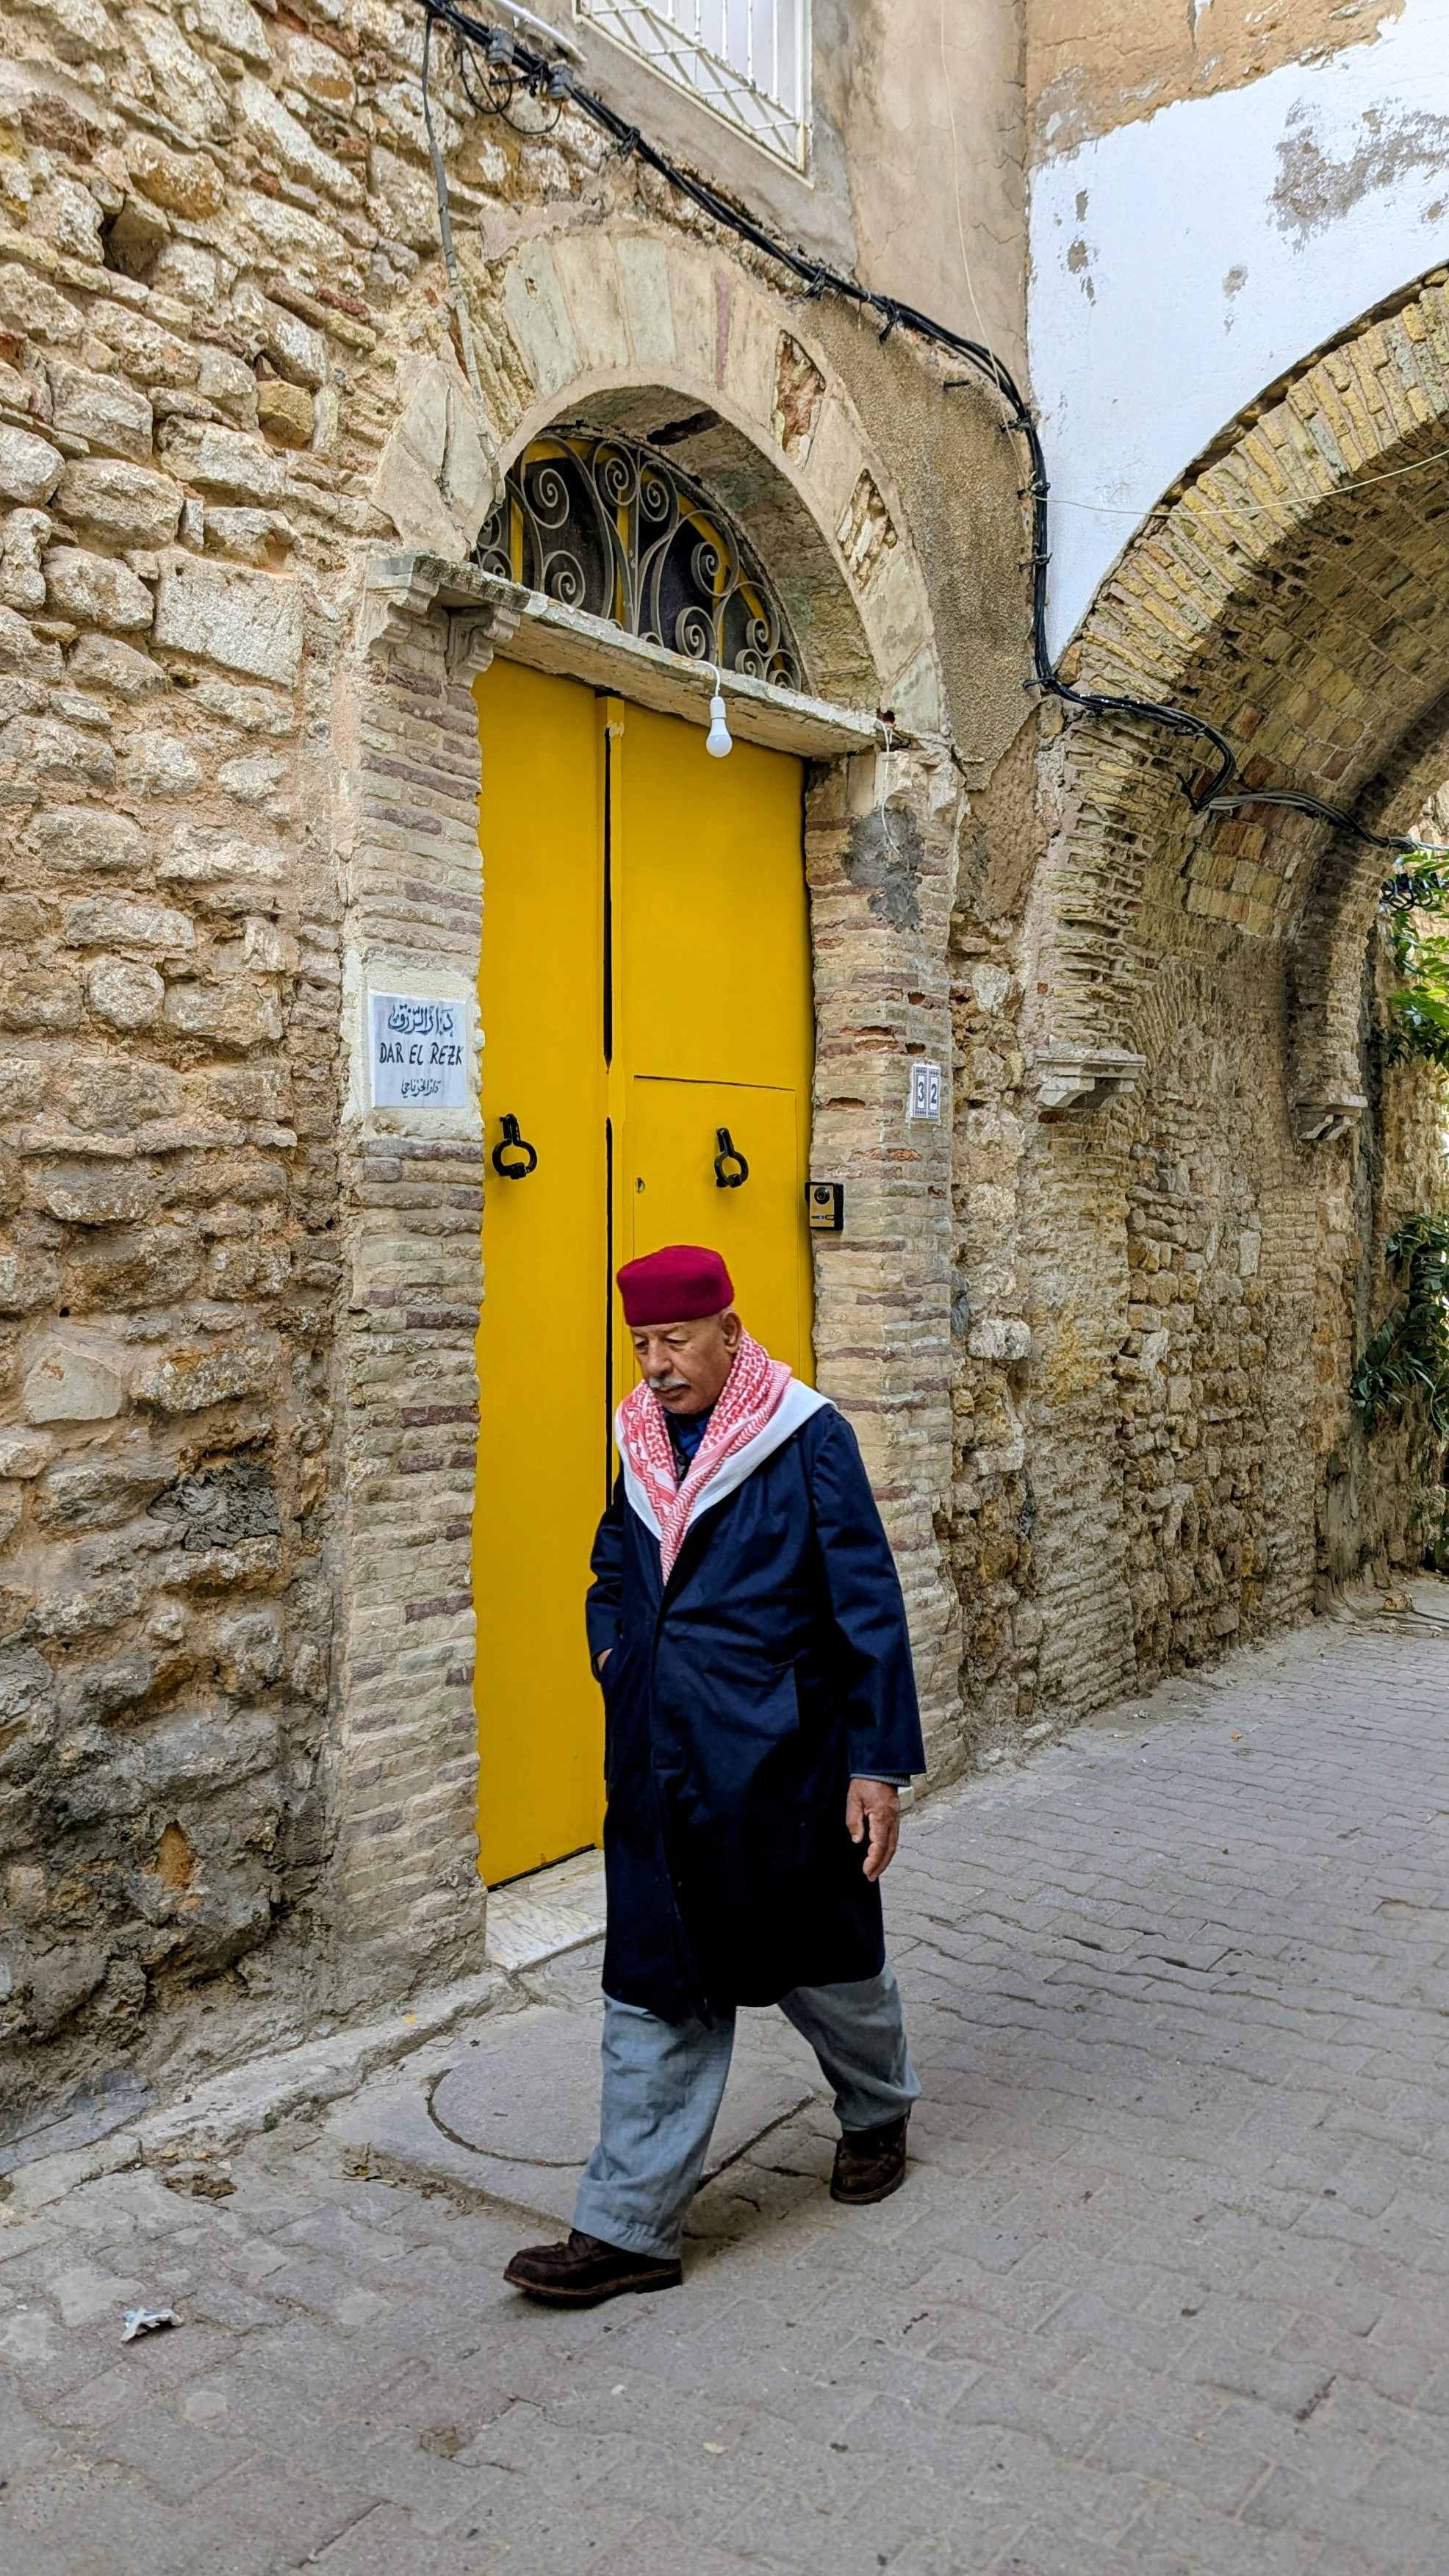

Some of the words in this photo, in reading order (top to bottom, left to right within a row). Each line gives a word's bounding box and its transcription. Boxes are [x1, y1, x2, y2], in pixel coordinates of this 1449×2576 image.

[379, 1042, 404, 1063] DAR
[409, 1044, 423, 1065] EL
[430, 1042, 464, 1066] REZK
[918, 1082, 937, 1103] 32
